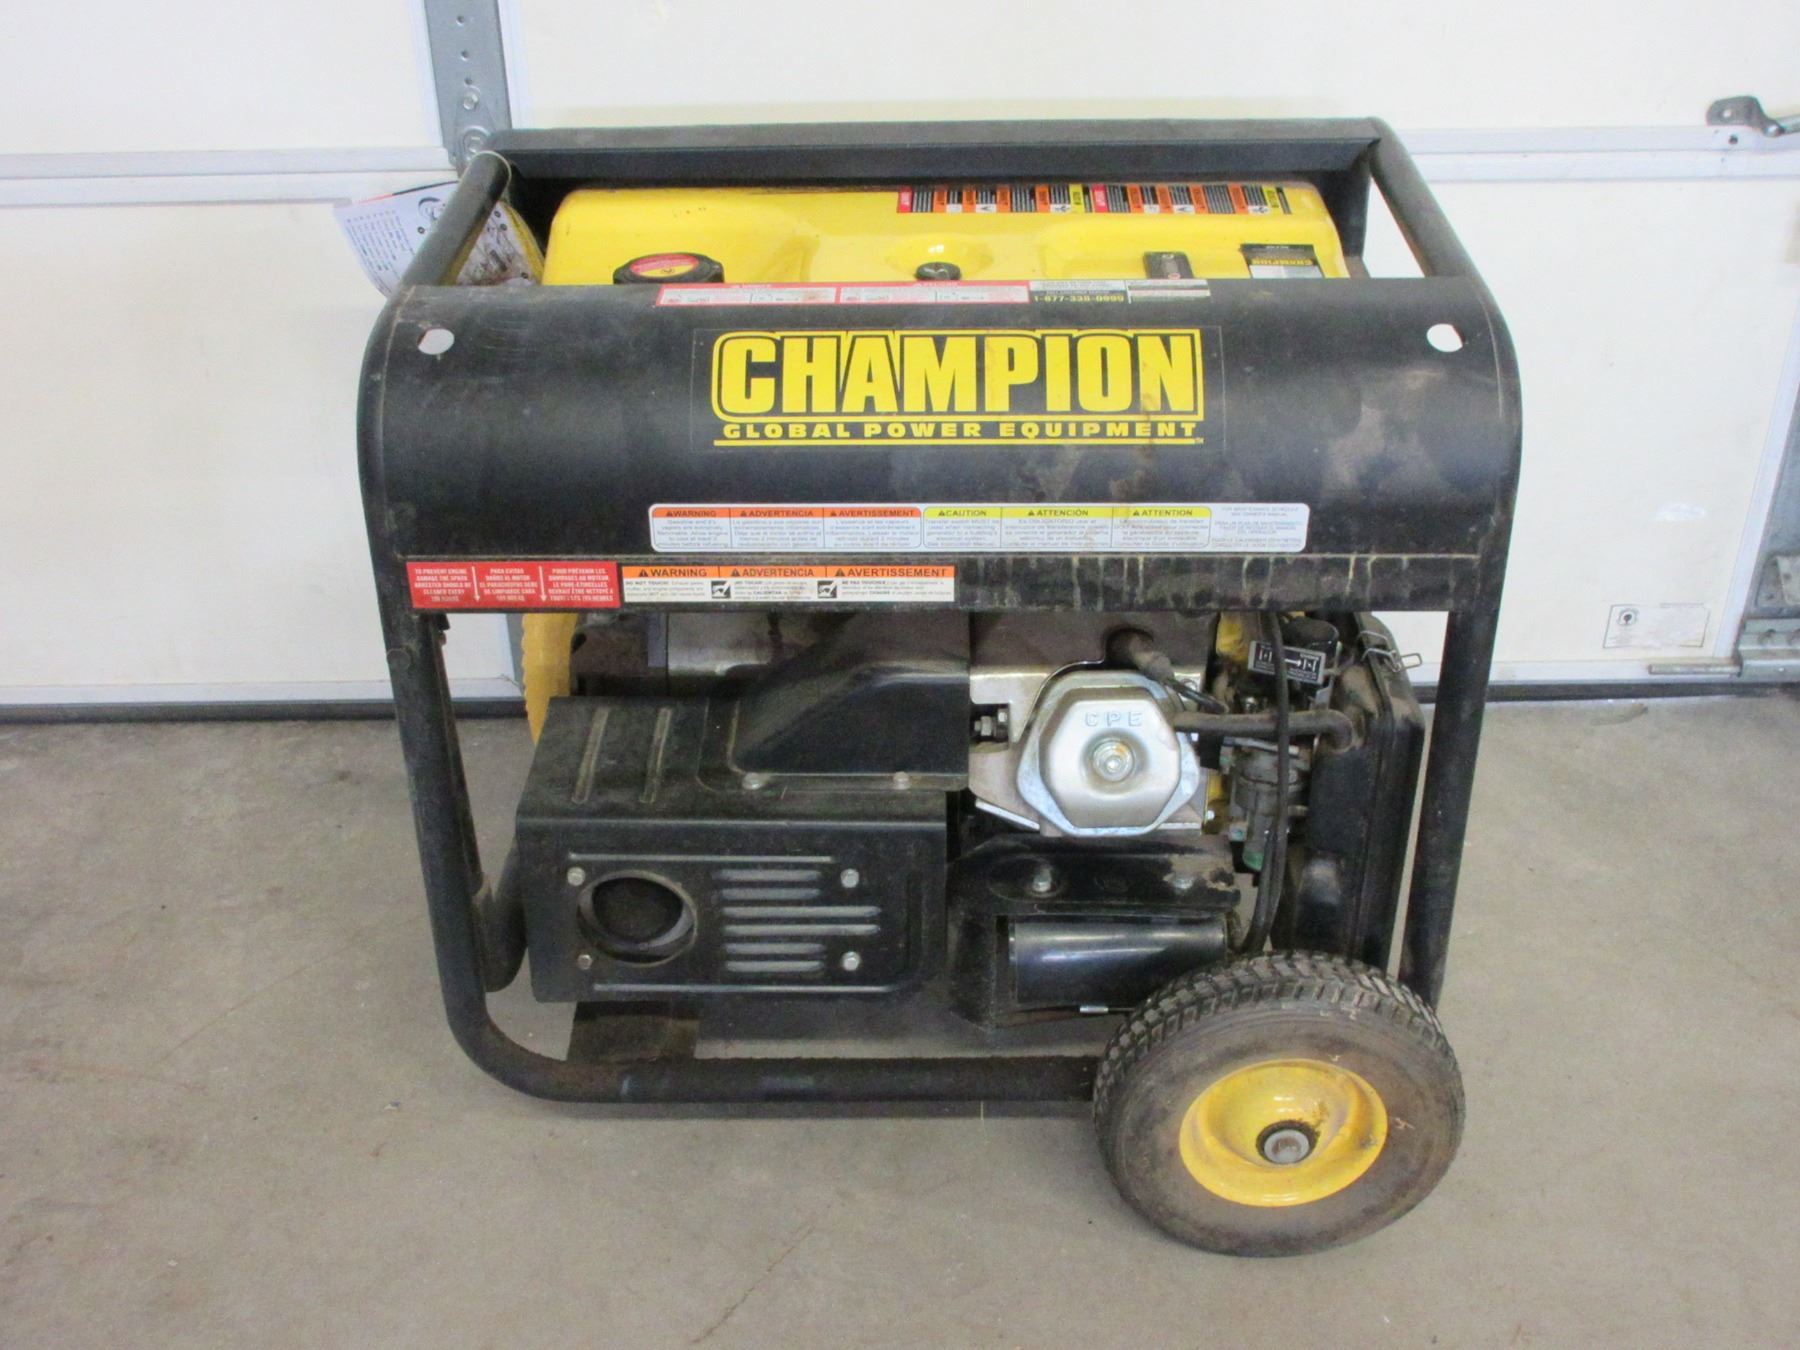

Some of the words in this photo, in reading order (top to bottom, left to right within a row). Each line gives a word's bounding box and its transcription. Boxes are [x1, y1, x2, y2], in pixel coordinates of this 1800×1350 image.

[720, 335, 1195, 414] CHAMPION
[723, 422, 851, 439] GLOBAL
[863, 422, 981, 438] POWER
[999, 422, 1197, 440] EQUIPMENT
[838, 509, 914, 517] AVERTISSEMENT
[1141, 509, 1193, 517] ATTENTION
[650, 568, 708, 577] WARNING
[742, 568, 815, 577] ADVERTENCIA
[847, 568, 947, 577] AVERTISSEMENT
